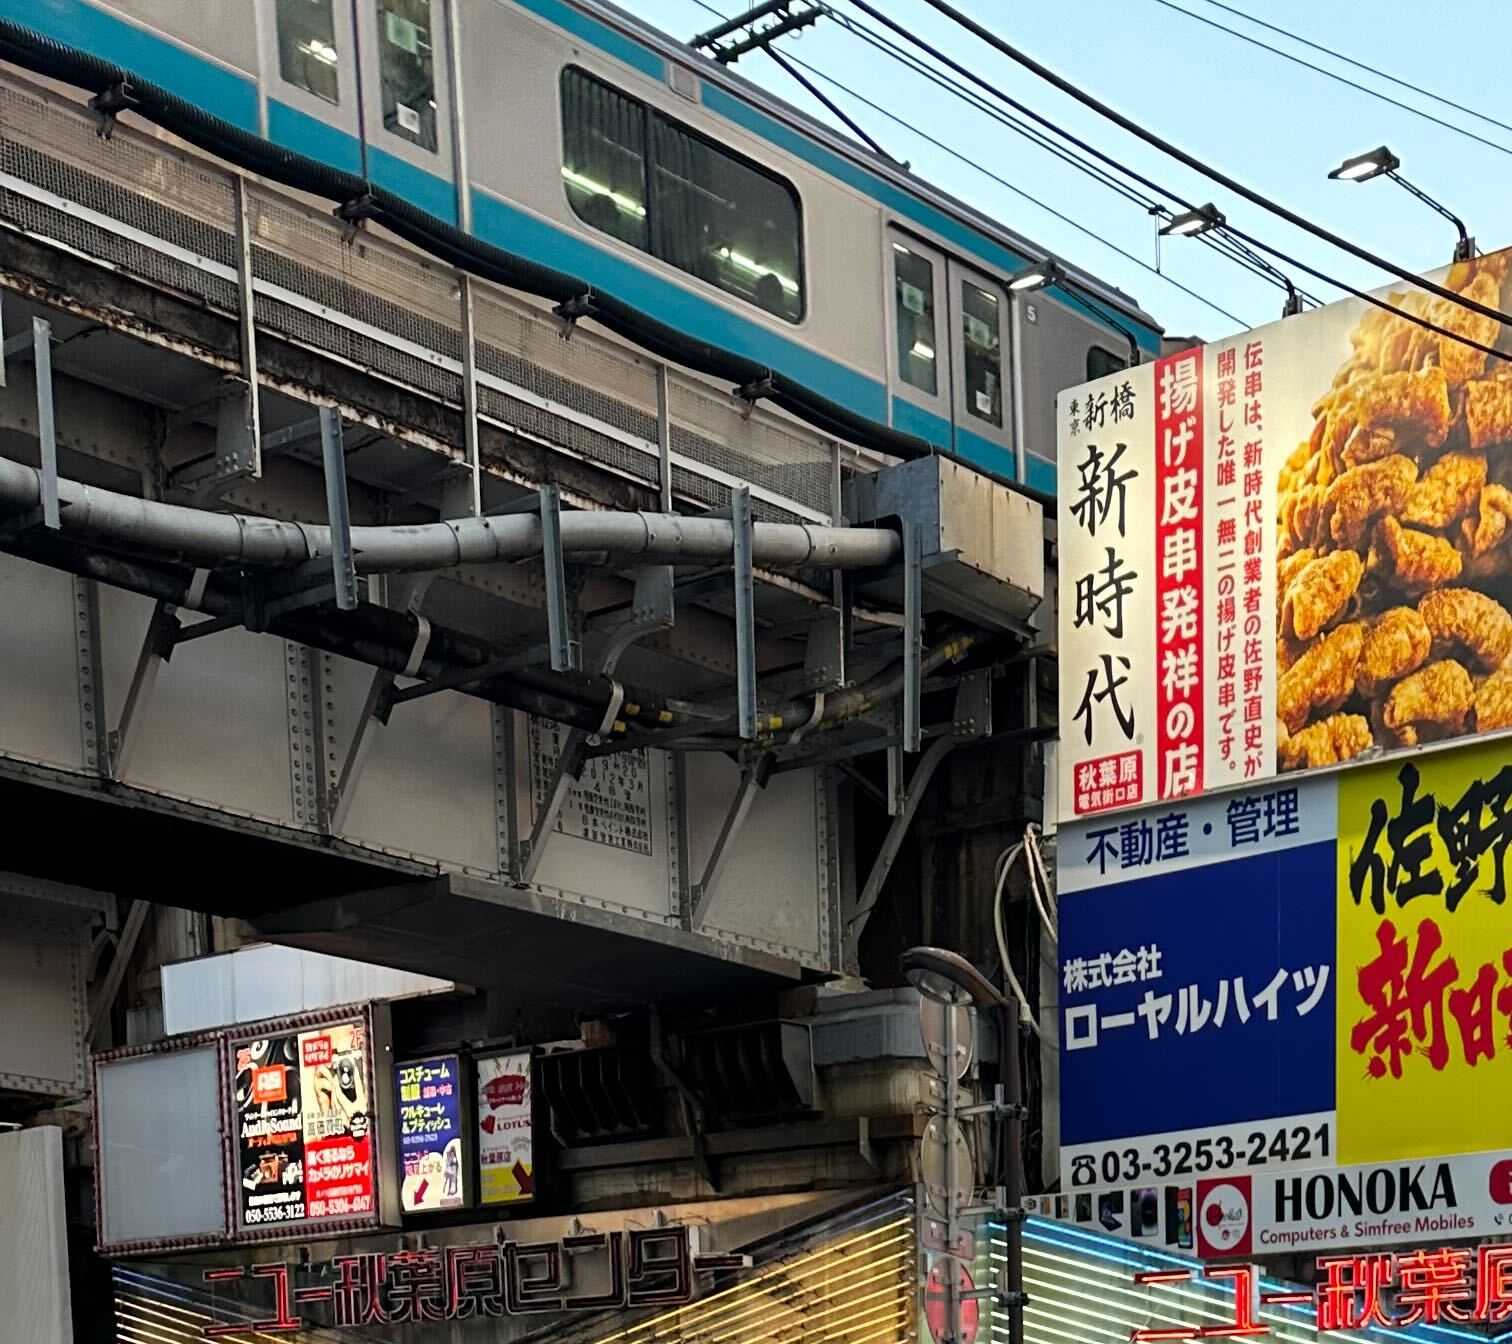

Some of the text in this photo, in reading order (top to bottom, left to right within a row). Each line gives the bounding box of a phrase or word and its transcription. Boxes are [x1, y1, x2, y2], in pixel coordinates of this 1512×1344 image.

[1027, 305, 1037, 322] 5
[1083, 384, 1136, 431] 新橋
[1158, 355, 1200, 799] 揚げ皮串発祥の店
[1215, 348, 1237, 772] 開発した唯一無二の揚げ皮串です。
[1243, 341, 1264, 779] 伝串は、新時代創業者の佐野直史が
[1069, 441, 1139, 748] 新時代
[1079, 756, 1138, 791] 秋葉原
[1085, 788, 1300, 875] 不動産・管理
[1063, 943, 1163, 994] 株式会社
[1065, 963, 1331, 1052] ローヤルハイツ
[400, 1063, 450, 1084] コスチューム
[241, 1113, 302, 1138] AudioSound
[401, 1103, 445, 1120] ワルキューレ
[497, 1119, 532, 1131] LOTUS
[1101, 1122, 1331, 1184] 03-3253-2421
[245, 1203, 305, 1224] 050-5536-3122
[1275, 1163, 1458, 1223] HONOKA
[1260, 1214, 1474, 1247] Computers & Simfree Mobiles
